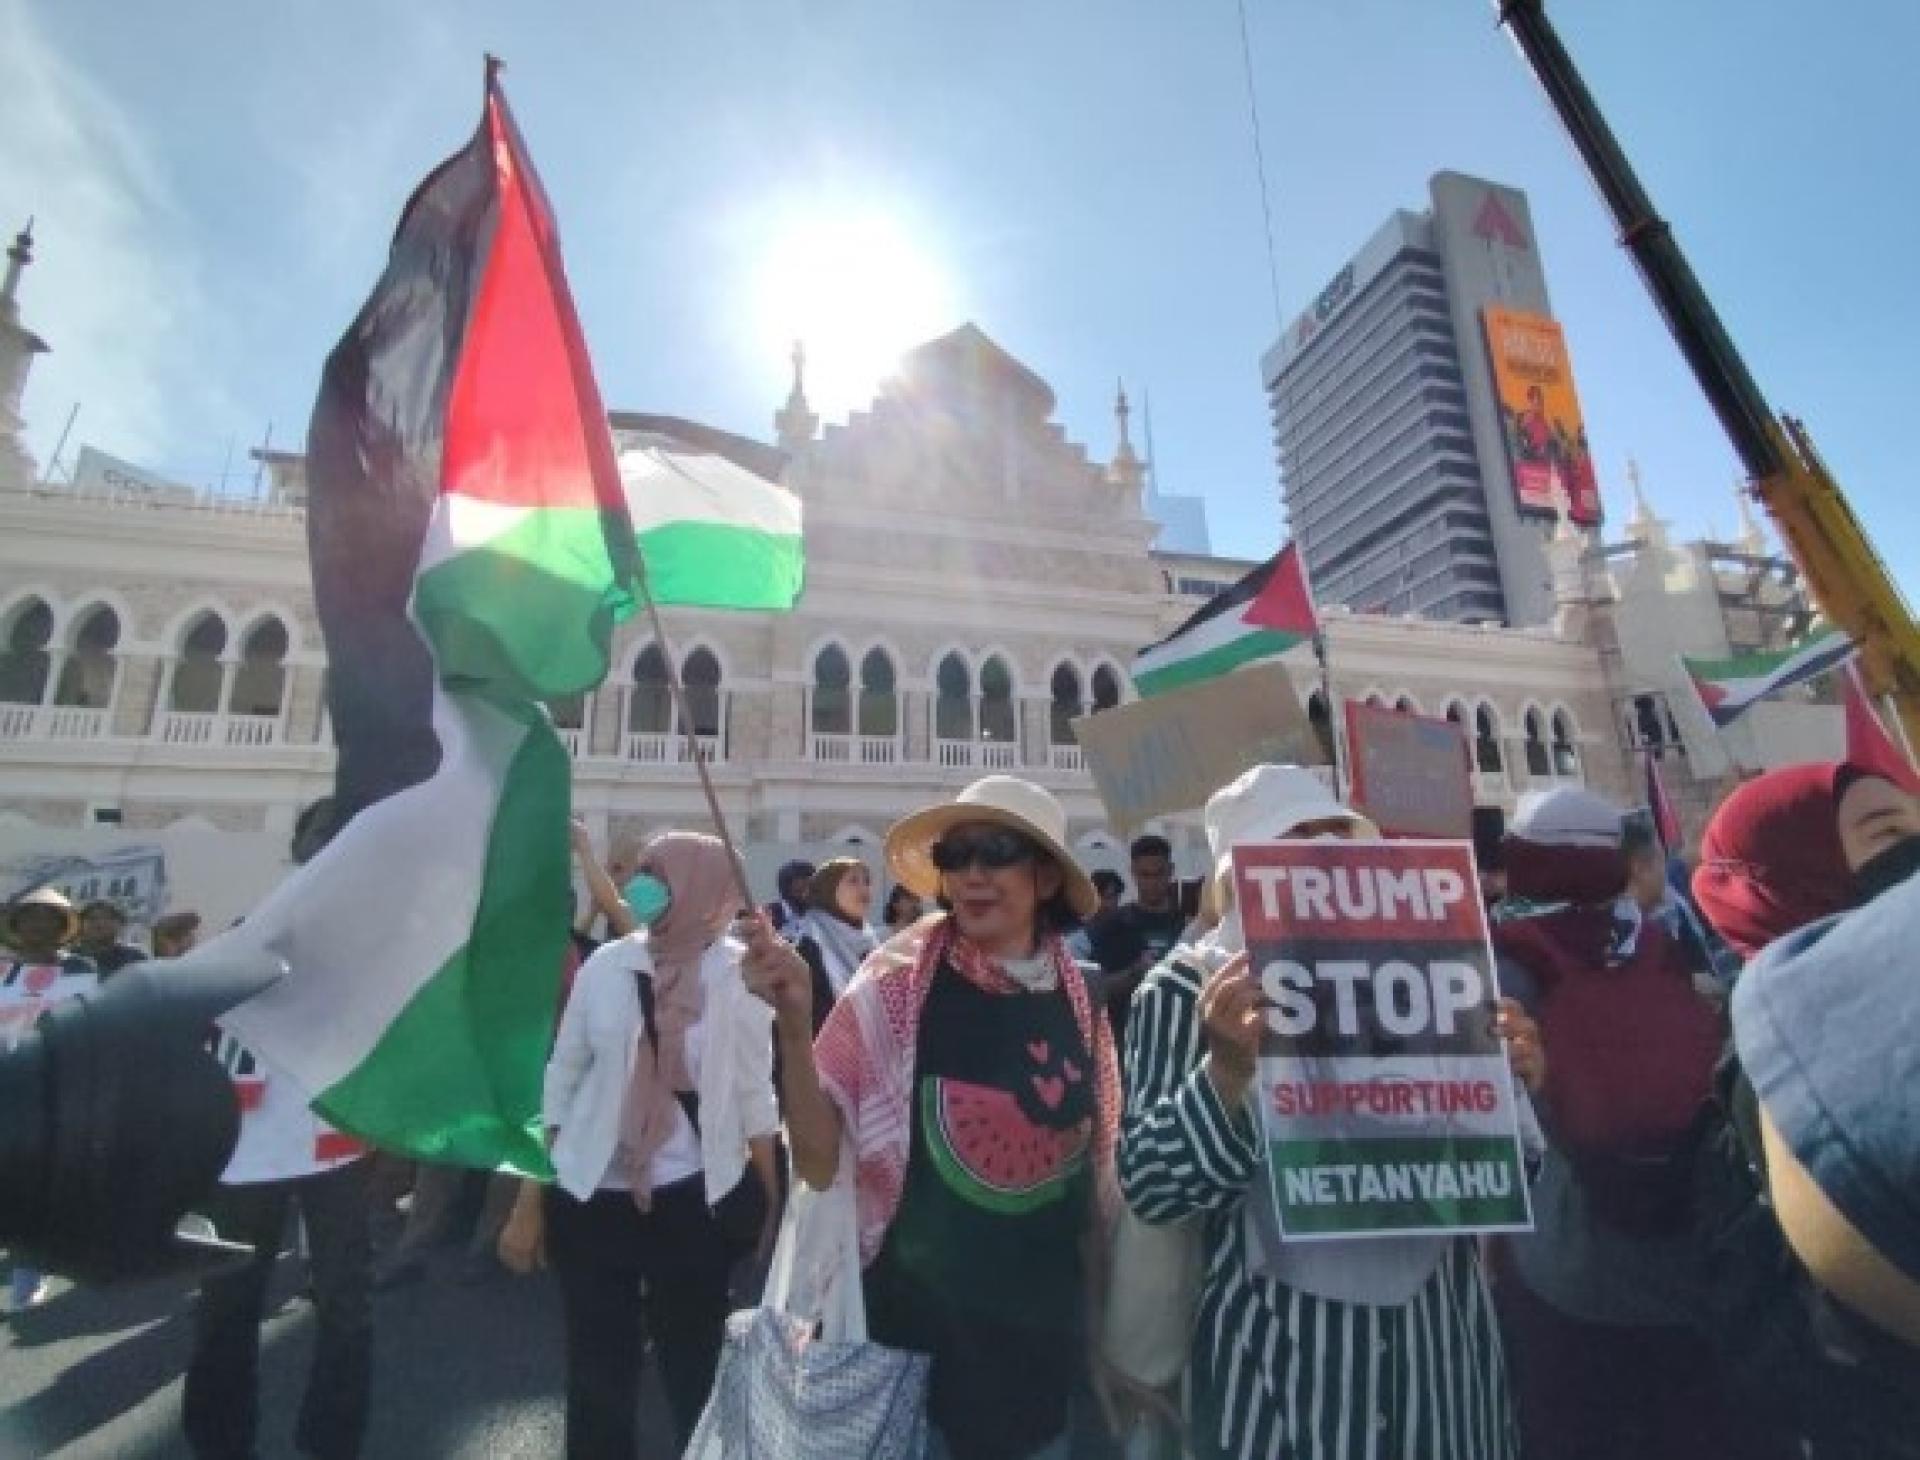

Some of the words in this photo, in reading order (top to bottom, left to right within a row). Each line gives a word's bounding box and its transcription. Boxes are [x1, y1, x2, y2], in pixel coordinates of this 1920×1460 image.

[1244, 866, 1465, 921] TRUMP
[1261, 959, 1482, 1036] STOP
[1275, 1081, 1497, 1115] SUPPORTING
[1283, 1161, 1511, 1205] NETANYAHU
